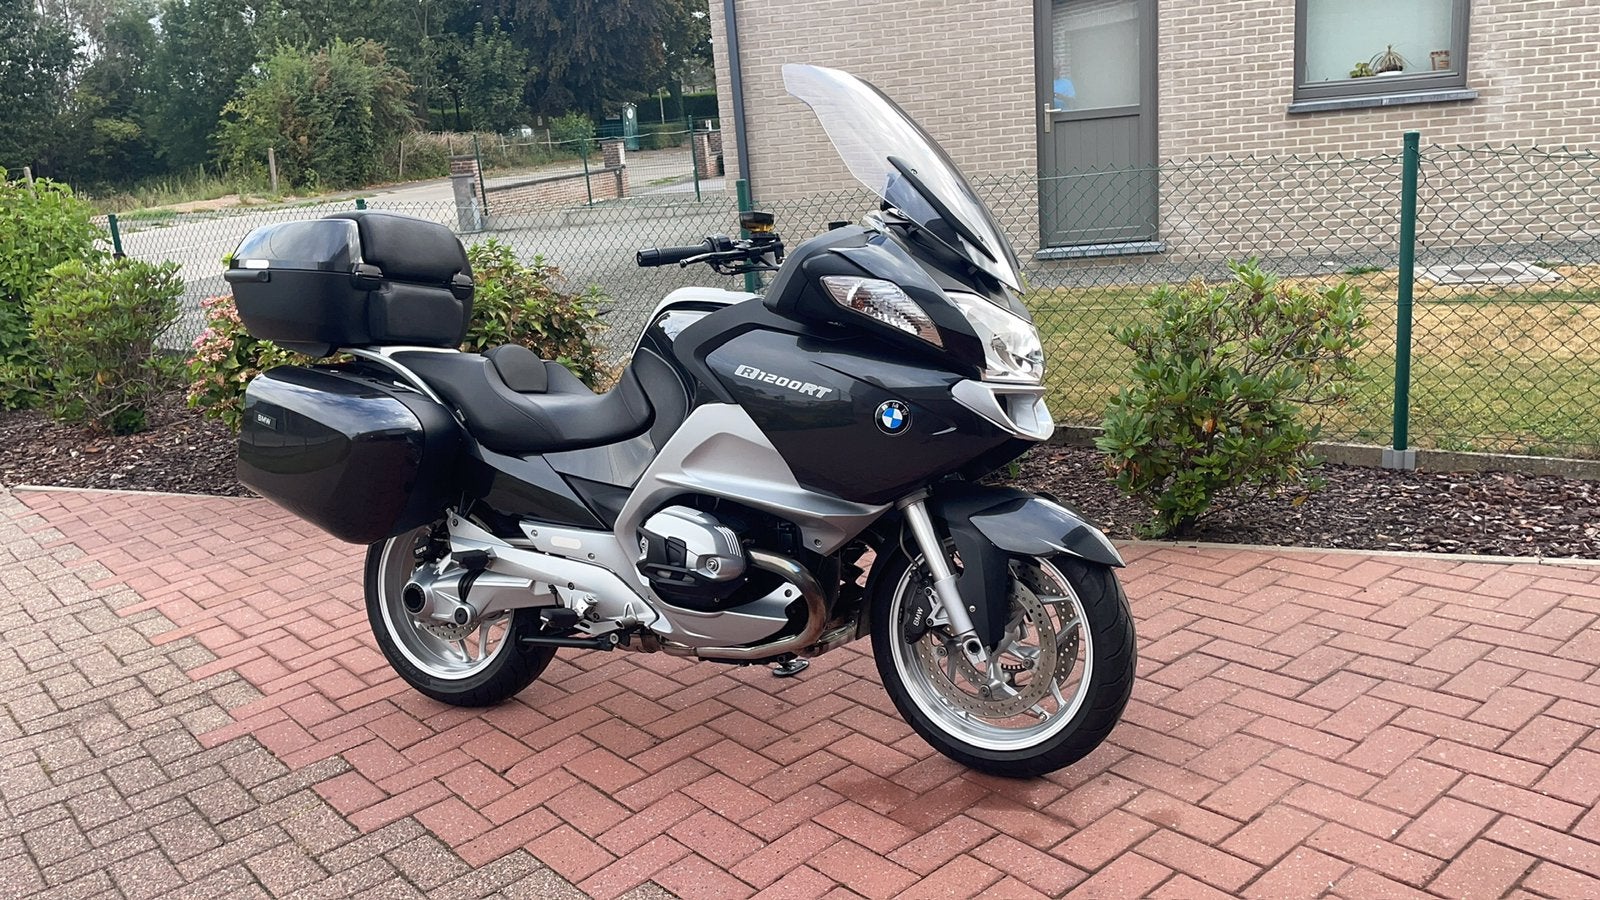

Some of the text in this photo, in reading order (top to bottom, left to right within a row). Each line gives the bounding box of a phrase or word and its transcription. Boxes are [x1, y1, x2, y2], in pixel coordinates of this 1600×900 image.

[734, 364, 833, 399] R1200RT
[880, 402, 909, 416] BMW
[257, 414, 271, 425] BMW
[912, 606, 924, 627] BMW
